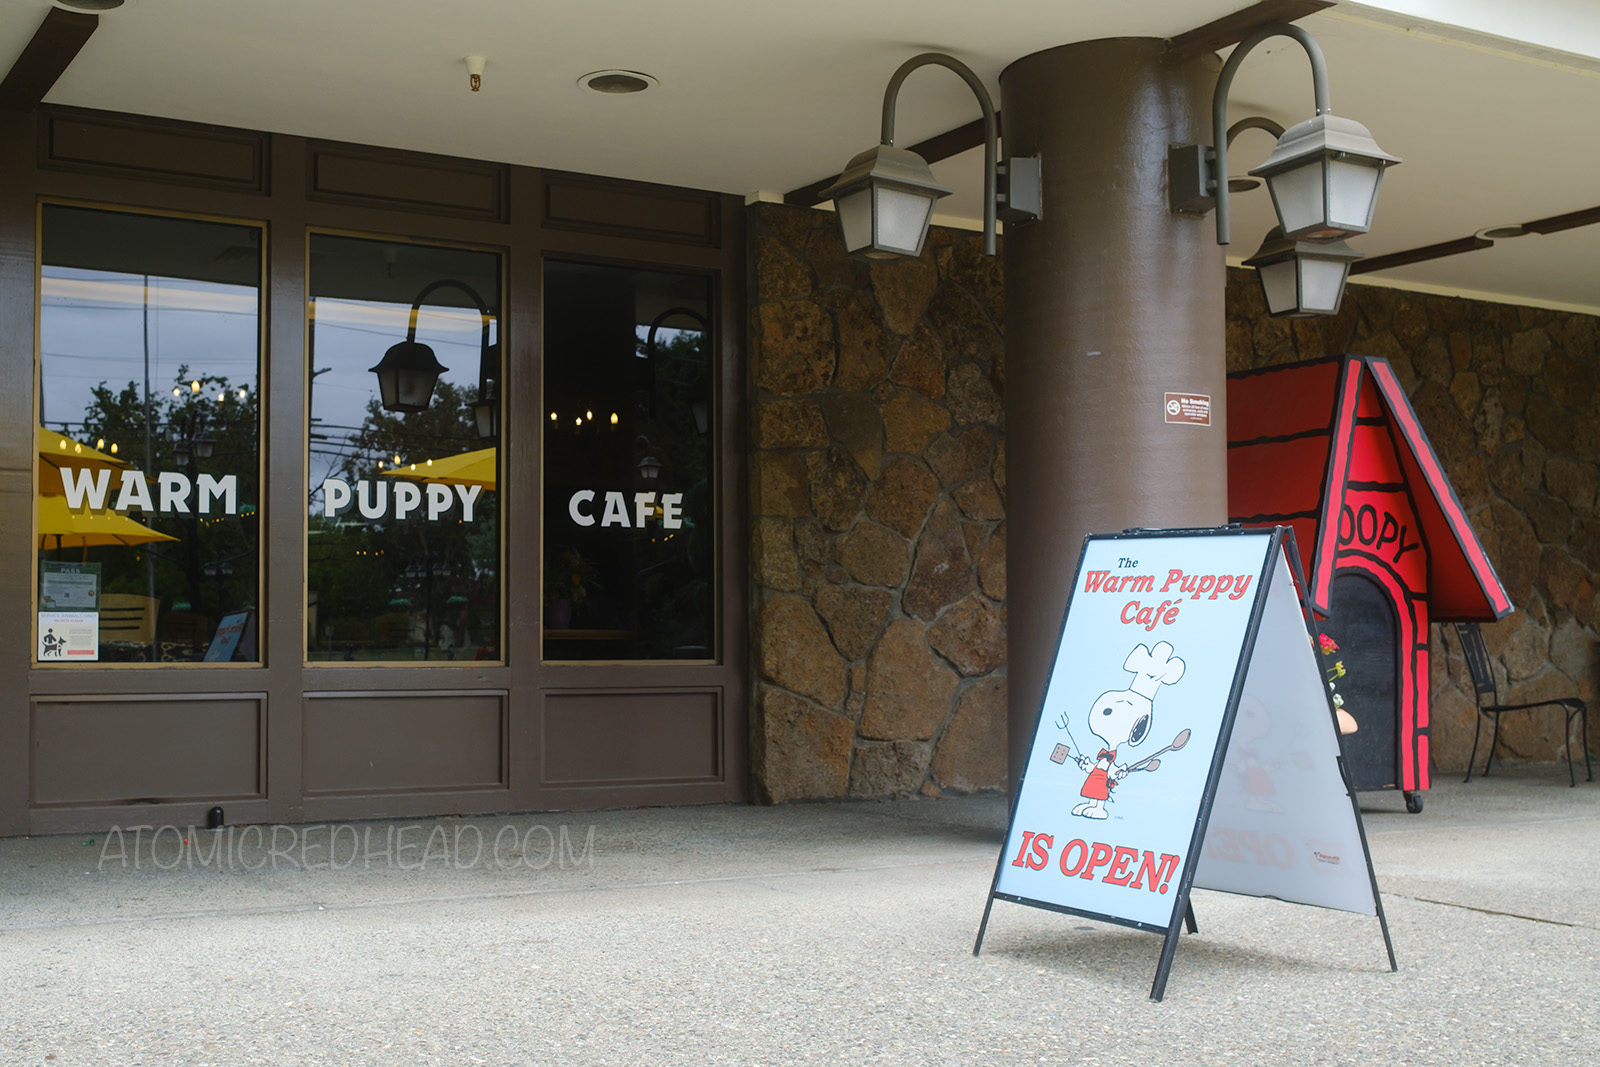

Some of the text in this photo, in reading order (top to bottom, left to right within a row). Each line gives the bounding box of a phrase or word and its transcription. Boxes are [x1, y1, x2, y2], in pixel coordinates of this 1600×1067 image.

[60, 467, 238, 515] WARM
[322, 476, 484, 522] PUPPY
[568, 489, 684, 529] CAFE
[1117, 556, 1139, 569] The
[1084, 569, 1253, 601] Warm Puppy
[1120, 598, 1183, 632] Café
[1012, 831, 1180, 895] IS OPEN!
